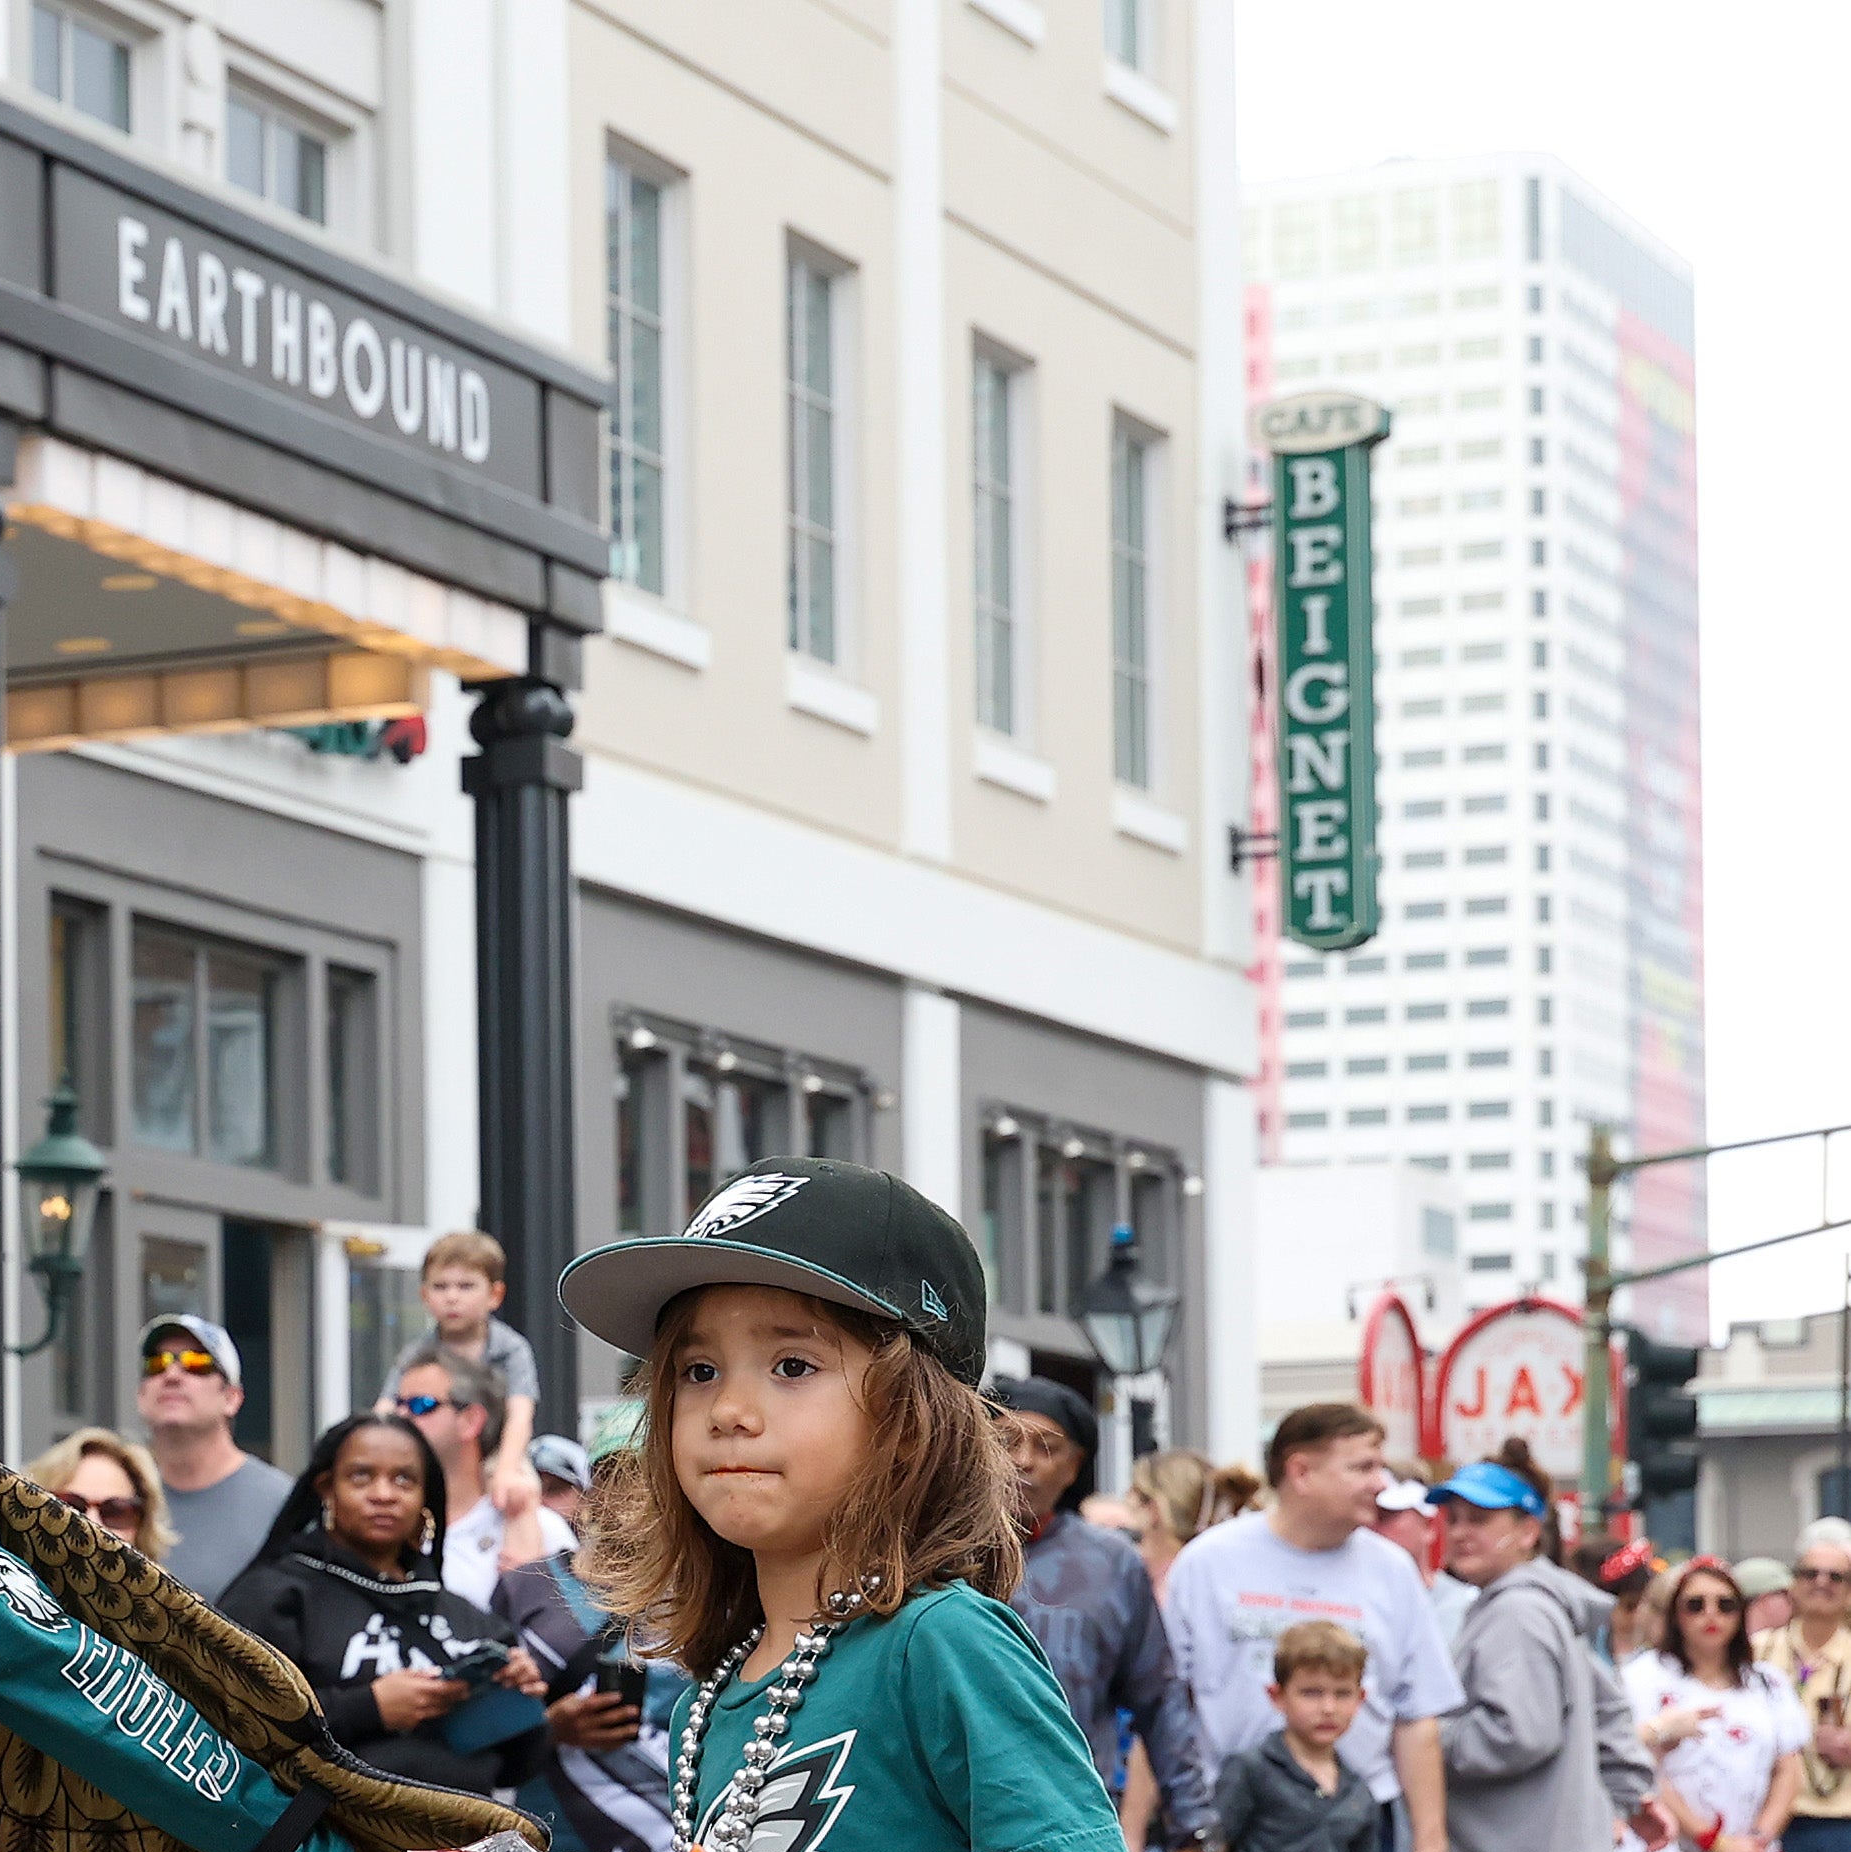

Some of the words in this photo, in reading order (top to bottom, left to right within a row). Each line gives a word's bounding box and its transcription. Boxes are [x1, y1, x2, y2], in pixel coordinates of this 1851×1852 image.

[117, 215, 491, 466] EARTHBOUND
[1284, 456, 1351, 930] BEIGNET
[61, 1623, 241, 1802] EAGLES
